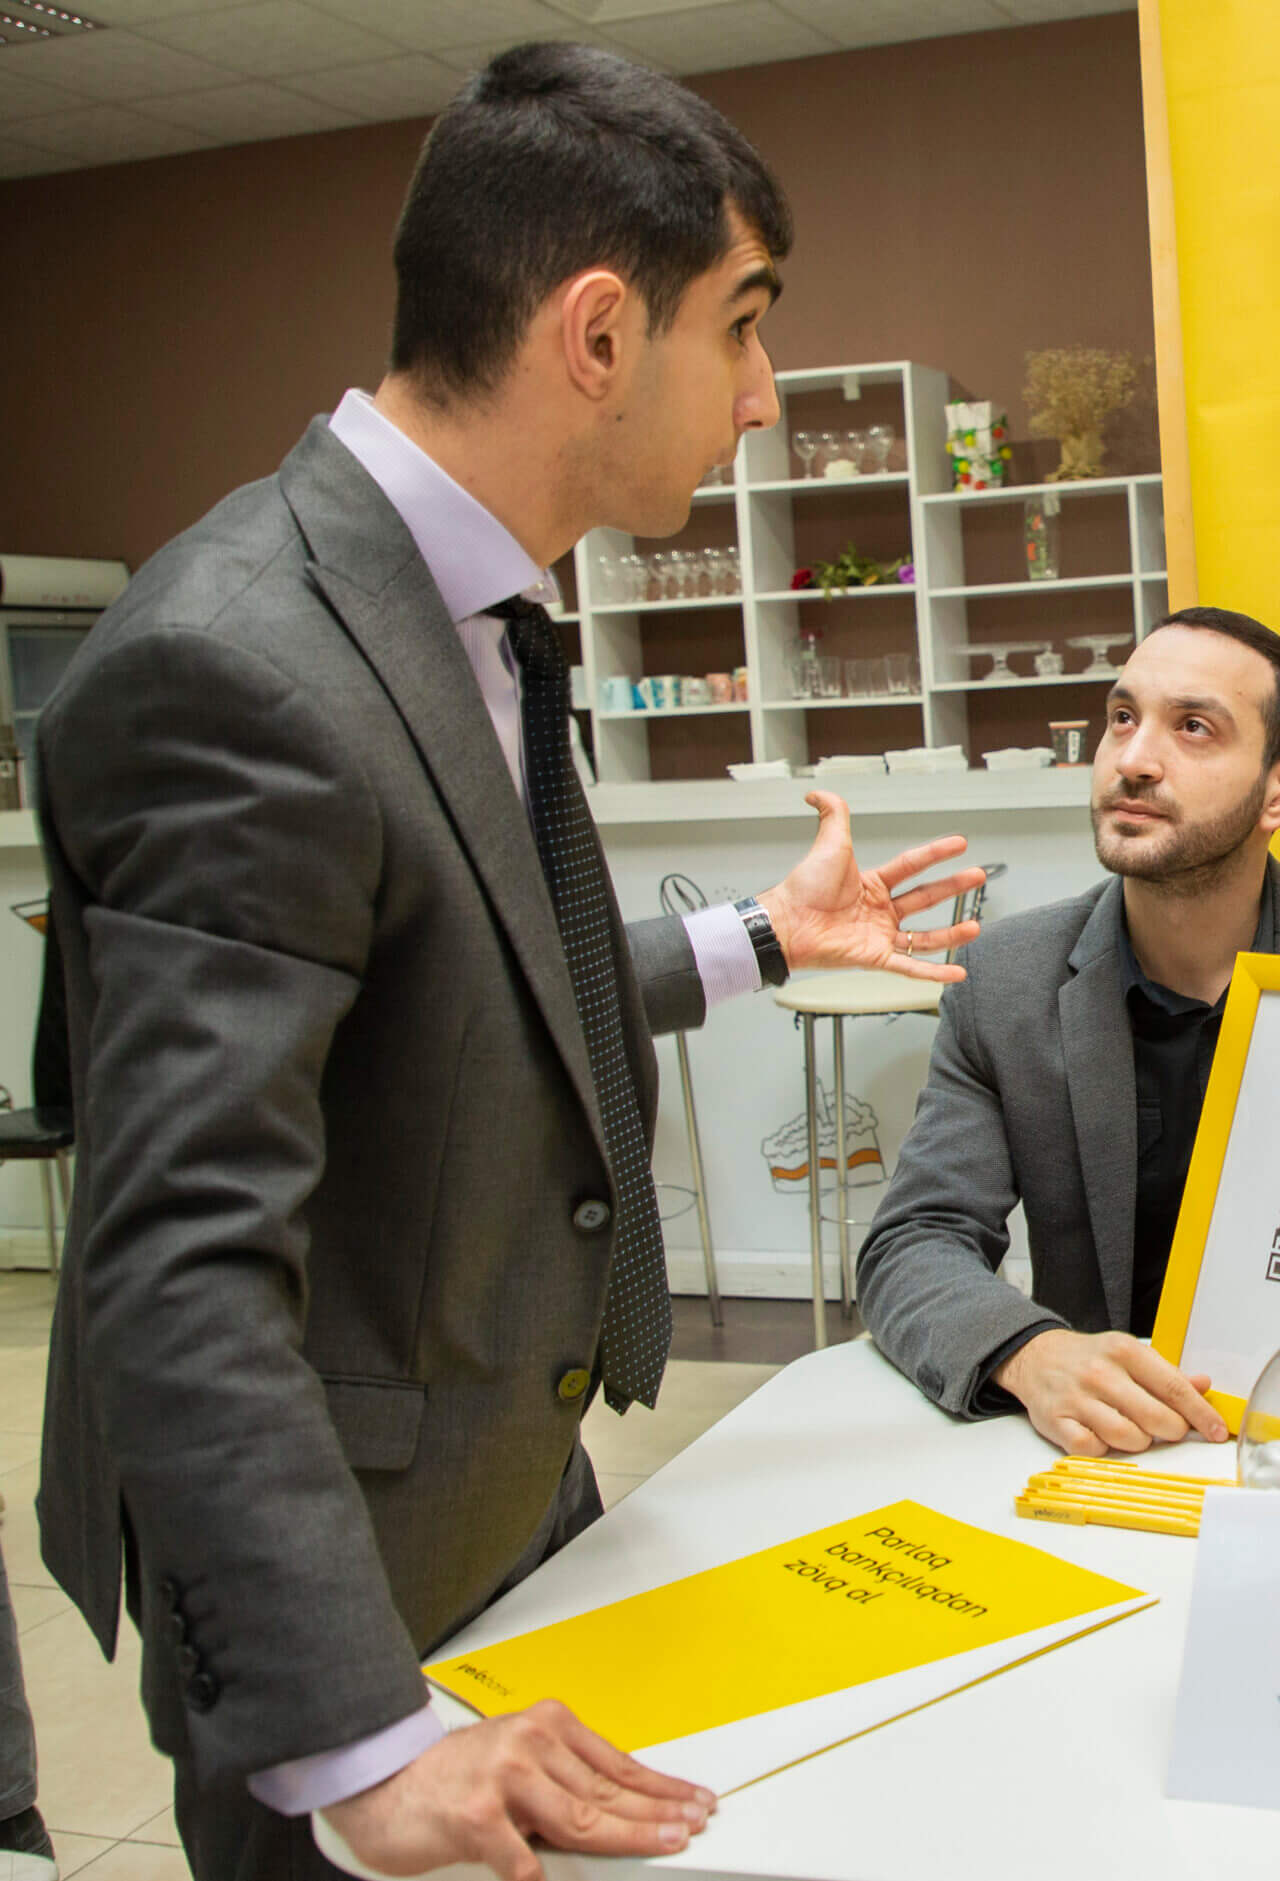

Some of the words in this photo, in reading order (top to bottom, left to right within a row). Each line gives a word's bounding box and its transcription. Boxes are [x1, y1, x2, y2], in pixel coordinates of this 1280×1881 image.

[864, 1526, 953, 1571] Parlaq
[783, 1559, 849, 1594] zövq
[845, 1588, 885, 1604] al
[824, 1541, 989, 1619] bankçılıqdan
